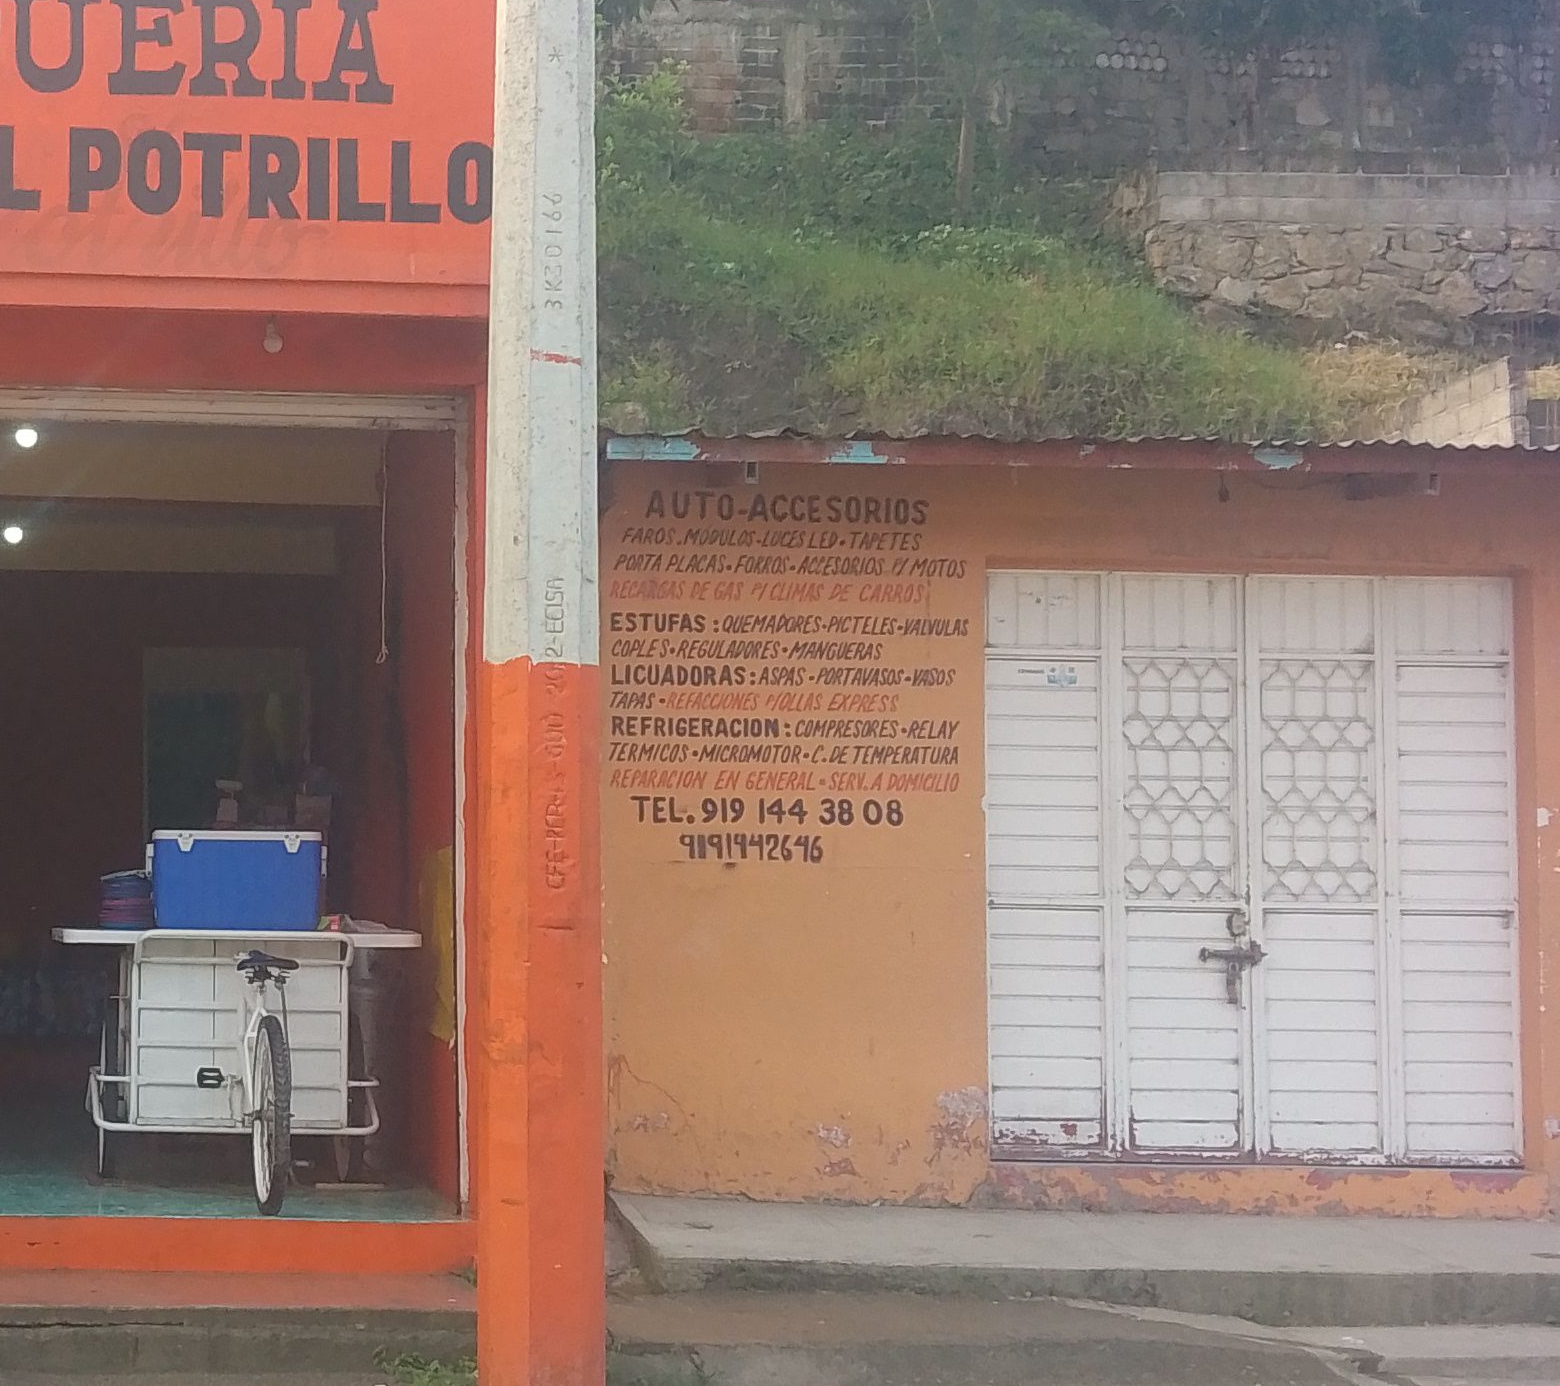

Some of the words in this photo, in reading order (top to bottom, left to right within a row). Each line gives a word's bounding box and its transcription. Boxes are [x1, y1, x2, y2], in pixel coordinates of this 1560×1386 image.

[67, 126, 494, 225] POTRILLO
[849, 532, 923, 551] TAPETES
[613, 553, 663, 572] PORTA
[665, 554, 727, 573] PLACAS
[733, 555, 790, 575] FORROS
[797, 556, 886, 577] ACCESORIOS
[909, 558, 967, 579] MOTOS
[609, 579, 687, 600] RECARGAS
[690, 581, 711, 601] DE
[714, 581, 744, 601] GAS
[769, 581, 825, 603] CLIMAS
[828, 584, 853, 602] DE
[859, 583, 925, 604] CARROS
[721, 614, 822, 634] QUEMADORES
[611, 637, 671, 658] COPLES
[676, 638, 781, 660] REGULADORES
[788, 640, 883, 660] MANGUERAS
[757, 665, 807, 686] ASPAS
[911, 668, 957, 687] VASOS
[608, 690, 656, 710] TAPAS
[665, 690, 760, 711] REFACCIONES
[826, 693, 900, 713] EXPRESS
[795, 718, 900, 739] COMPRESORES
[906, 719, 960, 740] RELAY
[608, 742, 690, 763] TERMICOS
[852, 745, 959, 764] TEMPERATURA
[609, 768, 708, 790] REPARACION
[714, 769, 741, 791] EN
[745, 771, 816, 791] GENERAL
[886, 772, 960, 793] DOMICILIO
[629, 795, 696, 825] TEL.
[701, 797, 745, 824] 919
[758, 797, 808, 825] 144
[818, 798, 855, 826] 38
[862, 798, 904, 827] 08
[678, 832, 824, 864] 9191442646
